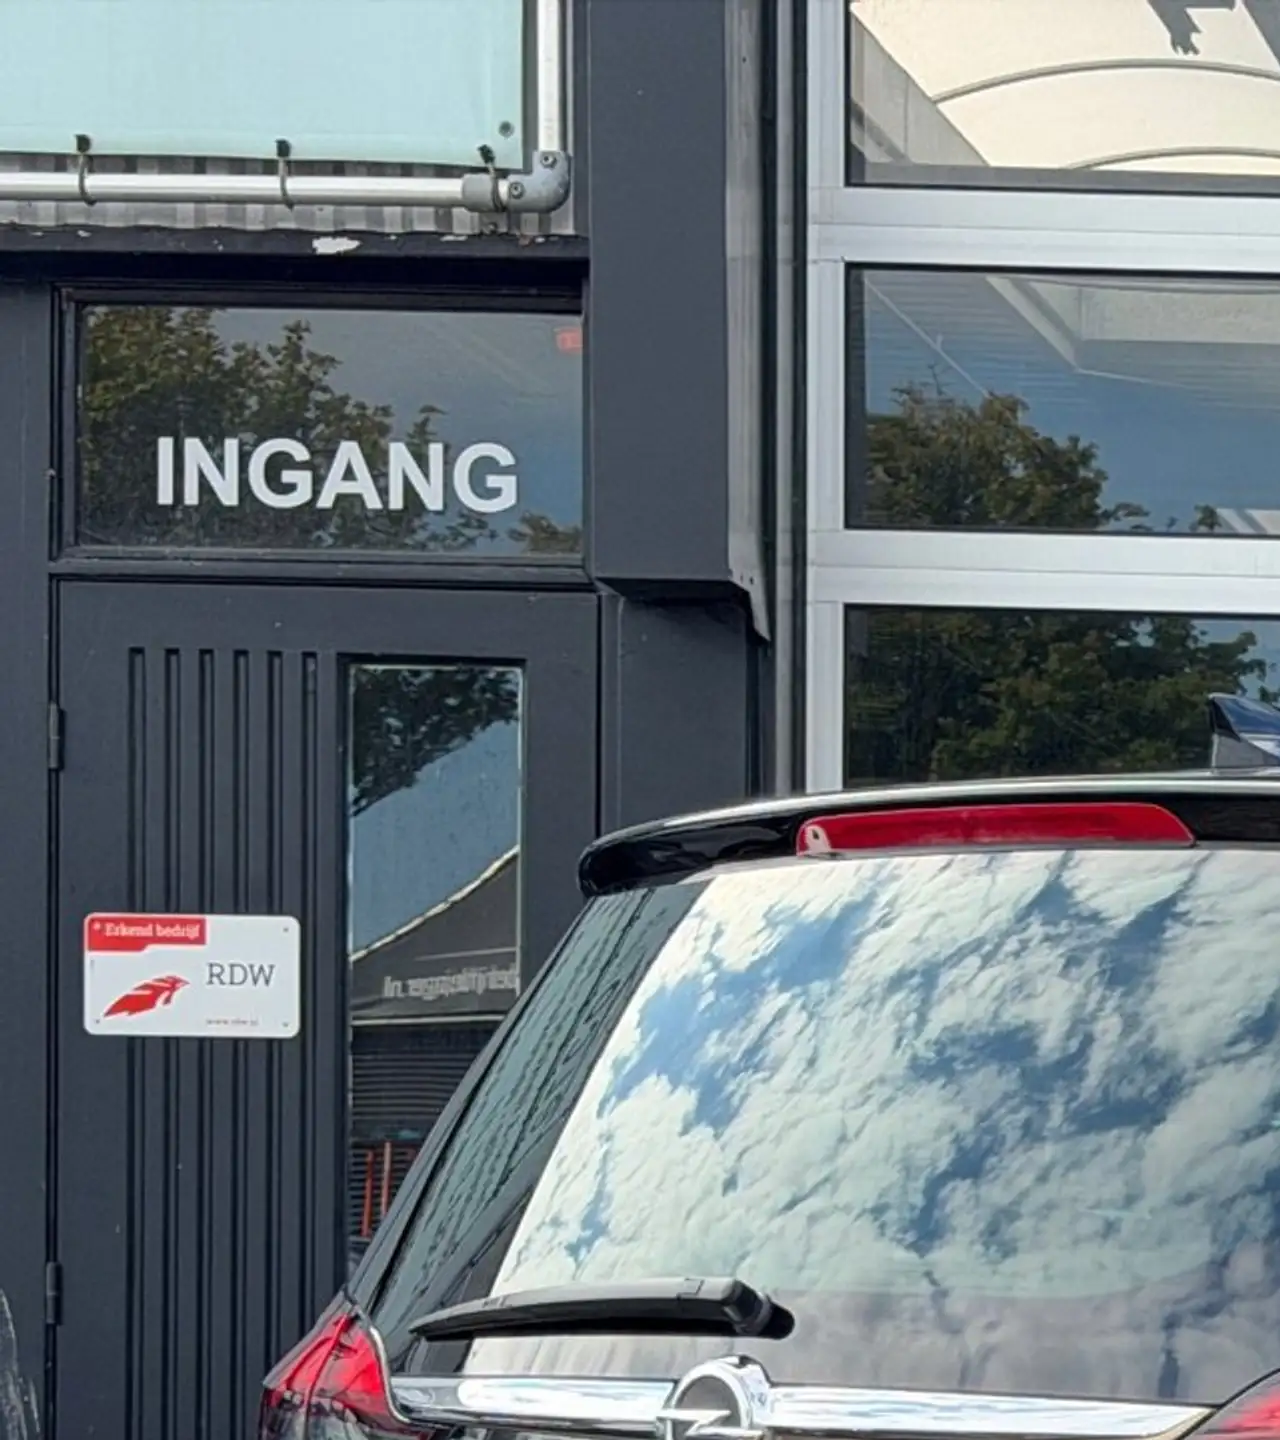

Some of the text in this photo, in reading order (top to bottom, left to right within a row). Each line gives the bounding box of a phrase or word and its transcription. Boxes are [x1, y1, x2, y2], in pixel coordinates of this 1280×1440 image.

[157, 436, 518, 513] INGANG
[105, 921, 201, 940] Erkend bedrijf
[206, 962, 275, 987] RDW
